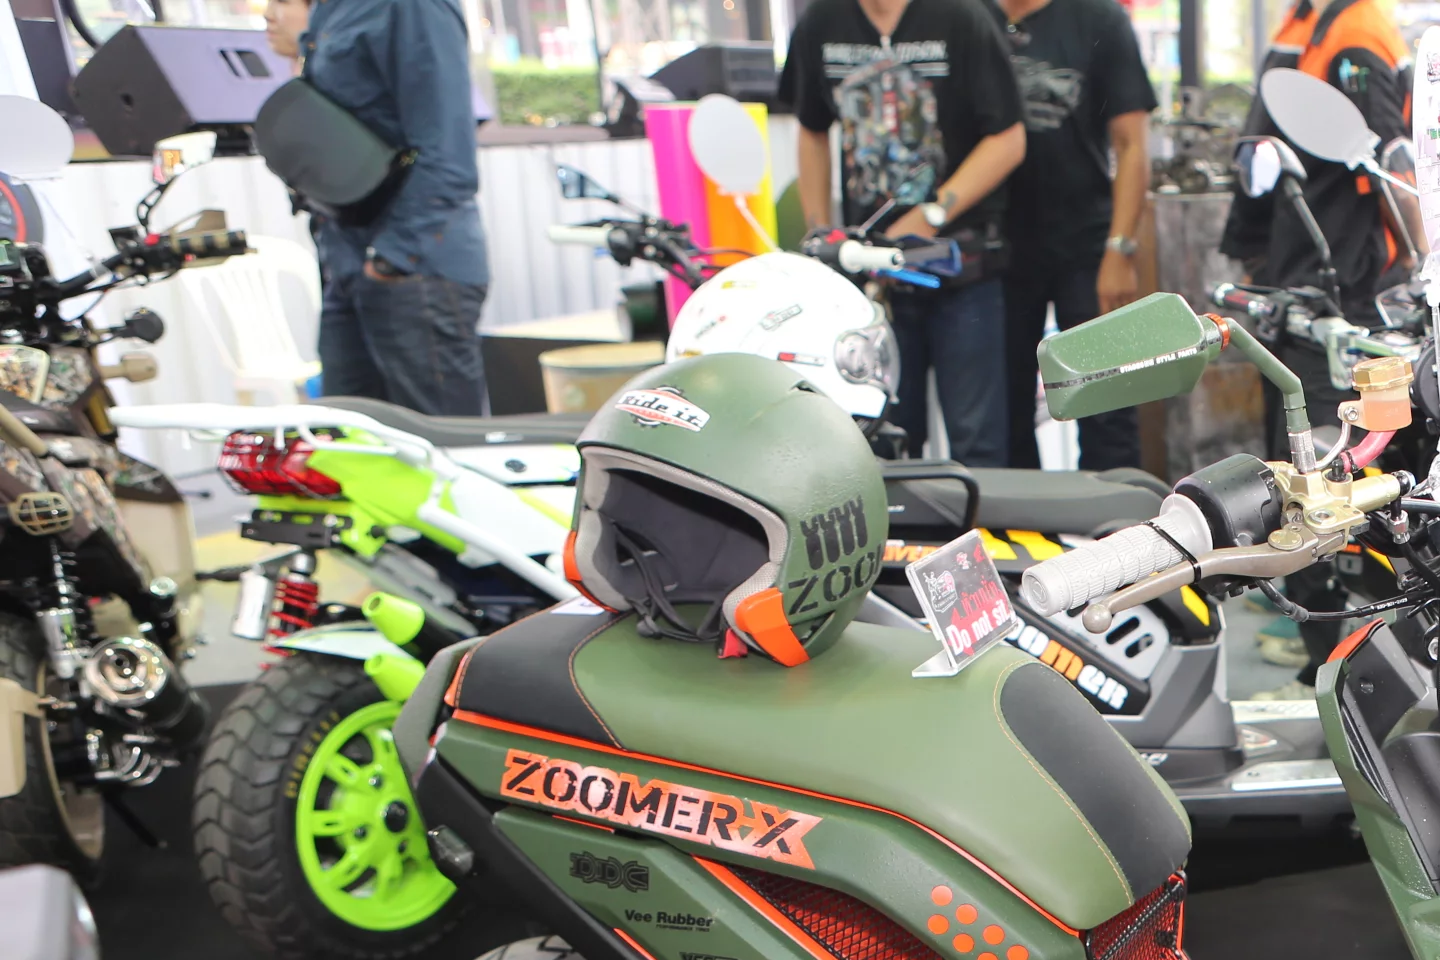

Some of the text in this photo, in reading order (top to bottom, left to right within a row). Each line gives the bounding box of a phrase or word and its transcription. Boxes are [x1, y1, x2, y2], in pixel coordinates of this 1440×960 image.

[788, 543, 882, 616] ZOO
[945, 624, 972, 656] Do
[971, 610, 994, 641] not
[506, 756, 800, 855] ZOOMER-X
[625, 909, 713, 927] Vee Rubber
